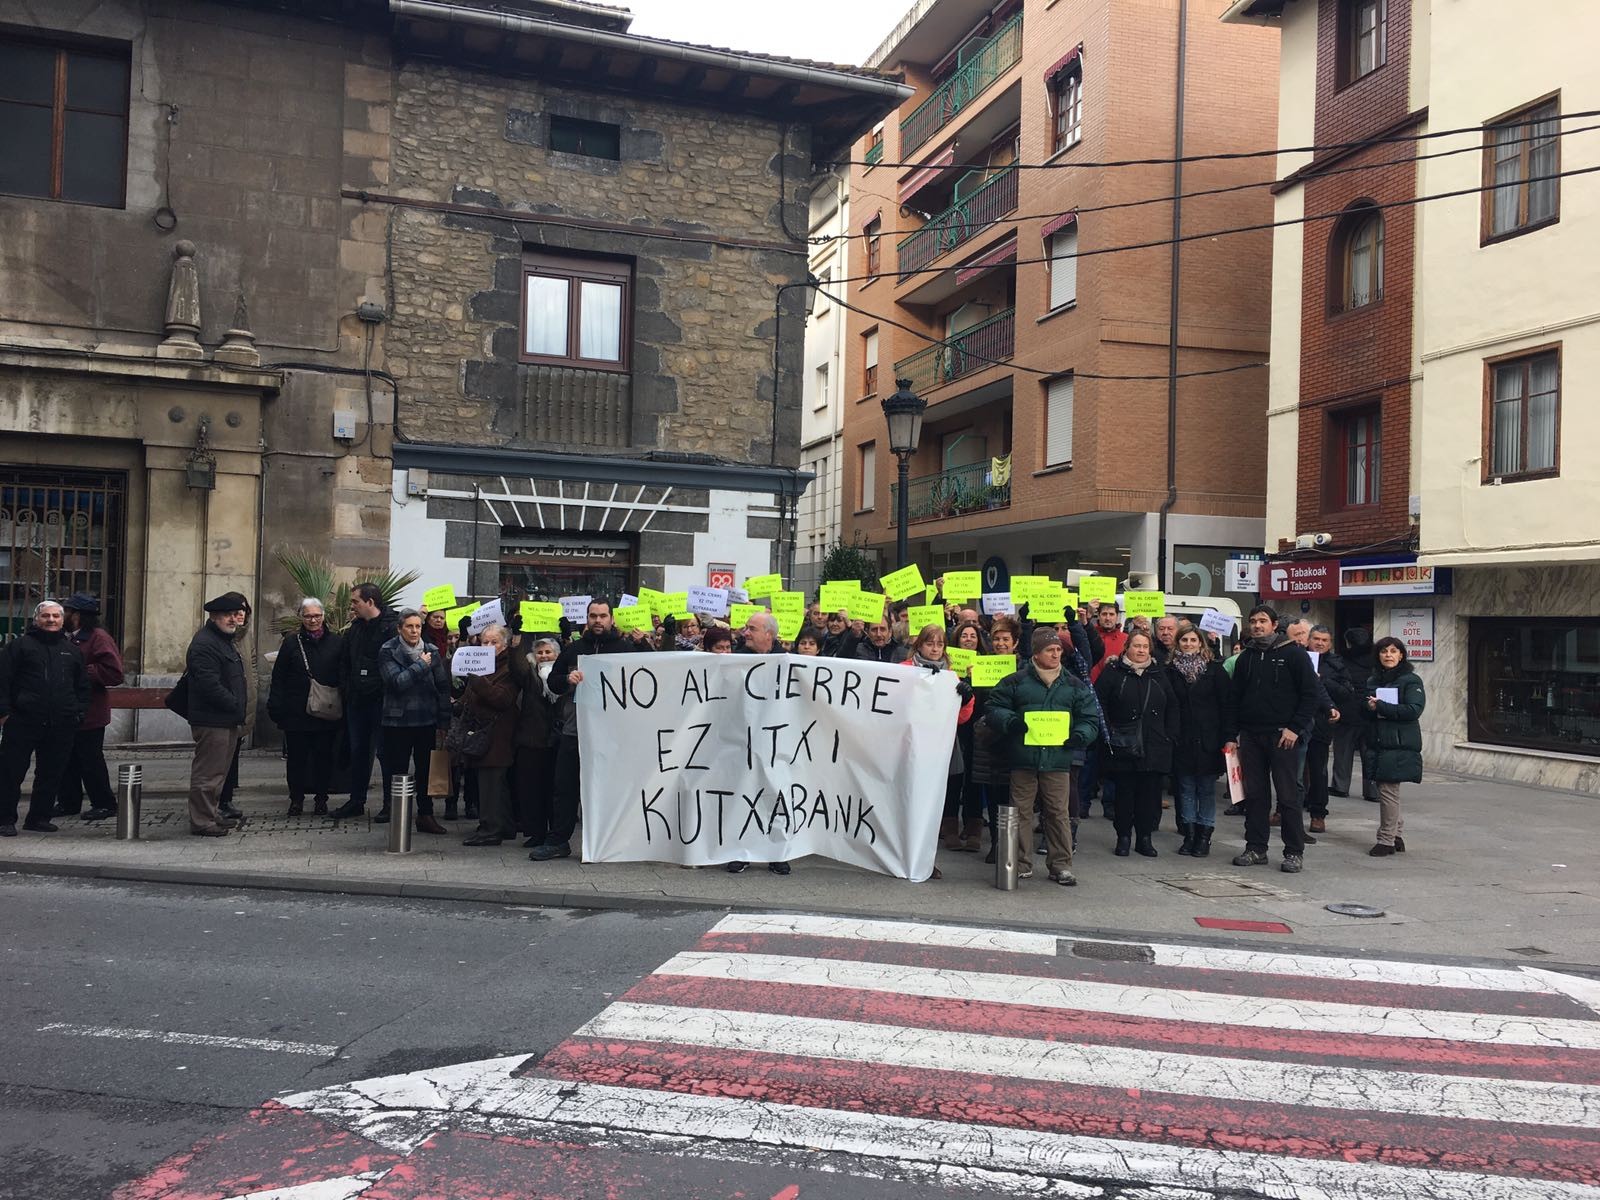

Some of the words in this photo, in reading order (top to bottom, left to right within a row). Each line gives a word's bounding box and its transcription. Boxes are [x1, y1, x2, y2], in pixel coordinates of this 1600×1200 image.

[1290, 566, 1327, 577] Tabakoak
[1290, 581, 1322, 591] Tabacos
[600, 666, 658, 711] NO
[681, 668, 727, 706] AL
[744, 662, 900, 715] CIERRE
[658, 722, 712, 773] EZ
[747, 720, 838, 770] ITXI
[641, 784, 876, 846] KUTXABANK
